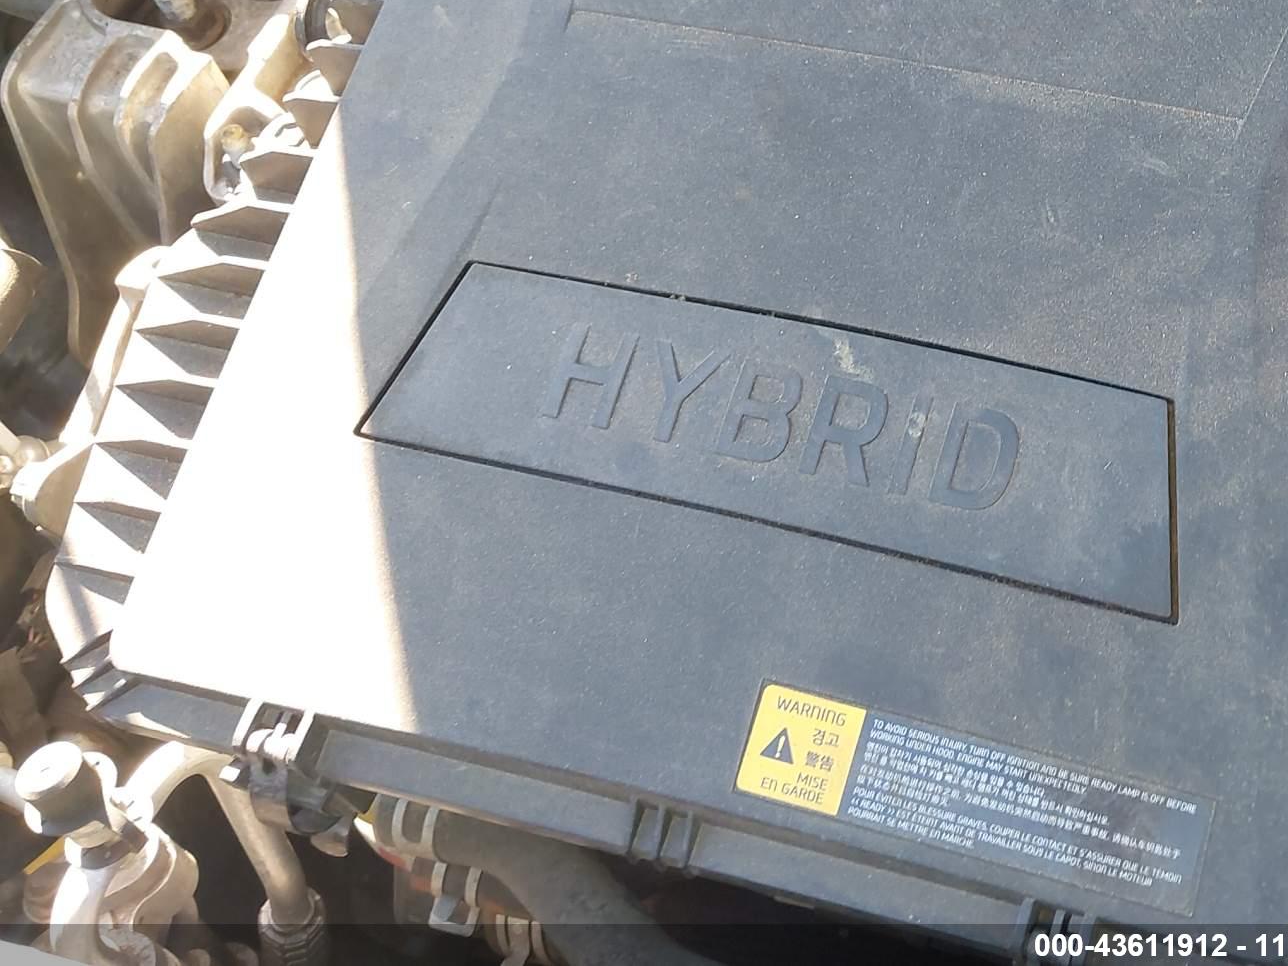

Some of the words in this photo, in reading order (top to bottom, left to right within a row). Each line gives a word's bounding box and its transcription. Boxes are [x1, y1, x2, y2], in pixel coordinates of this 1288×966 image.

[541, 324, 1020, 510] HYBRID
[777, 695, 848, 727] WARNING
[812, 728, 840, 747] 경고
[804, 750, 834, 772] 警告
[869, 729, 904, 745] WORKING
[905, 738, 932, 753] UNDER
[956, 752, 984, 767] ENGINE
[984, 759, 1003, 772] MAY
[1003, 764, 1027, 779] START
[872, 718, 884, 729] TO
[884, 722, 907, 735] AVOID
[907, 728, 939, 744] SERIOUS
[968, 745, 989, 757] TURN
[990, 750, 1006, 762] OFF
[1006, 755, 1039, 771] IGNITION
[1040, 763, 1056, 775] AND
[1069, 771, 1089, 784] SURE
[1090, 777, 1116, 792] READY
[1117, 784, 1139, 798] LAMP
[1149, 793, 1163, 805] OFF
[1165, 797, 1197, 814] BEFORE
[760, 777, 778, 792] EN
[781, 783, 824, 804] GARDE
[796, 772, 828, 792] MISE
[847, 805, 885, 824] POURRAIT
[896, 819, 928, 836] METTRE
[852, 785, 874, 799] POUR
[902, 799, 917, 811] LES
[989, 823, 1020, 840] COUPER
[1031, 834, 1065, 852] CONTACT
[1121, 859, 1138, 872] QUE
[859, 798, 885, 813] READY
[895, 808, 910, 820] EST
[939, 820, 963, 835] AVANT
[977, 831, 1021, 851] TRAVAILLER
[1118, 869, 1152, 887] MOTEUR
